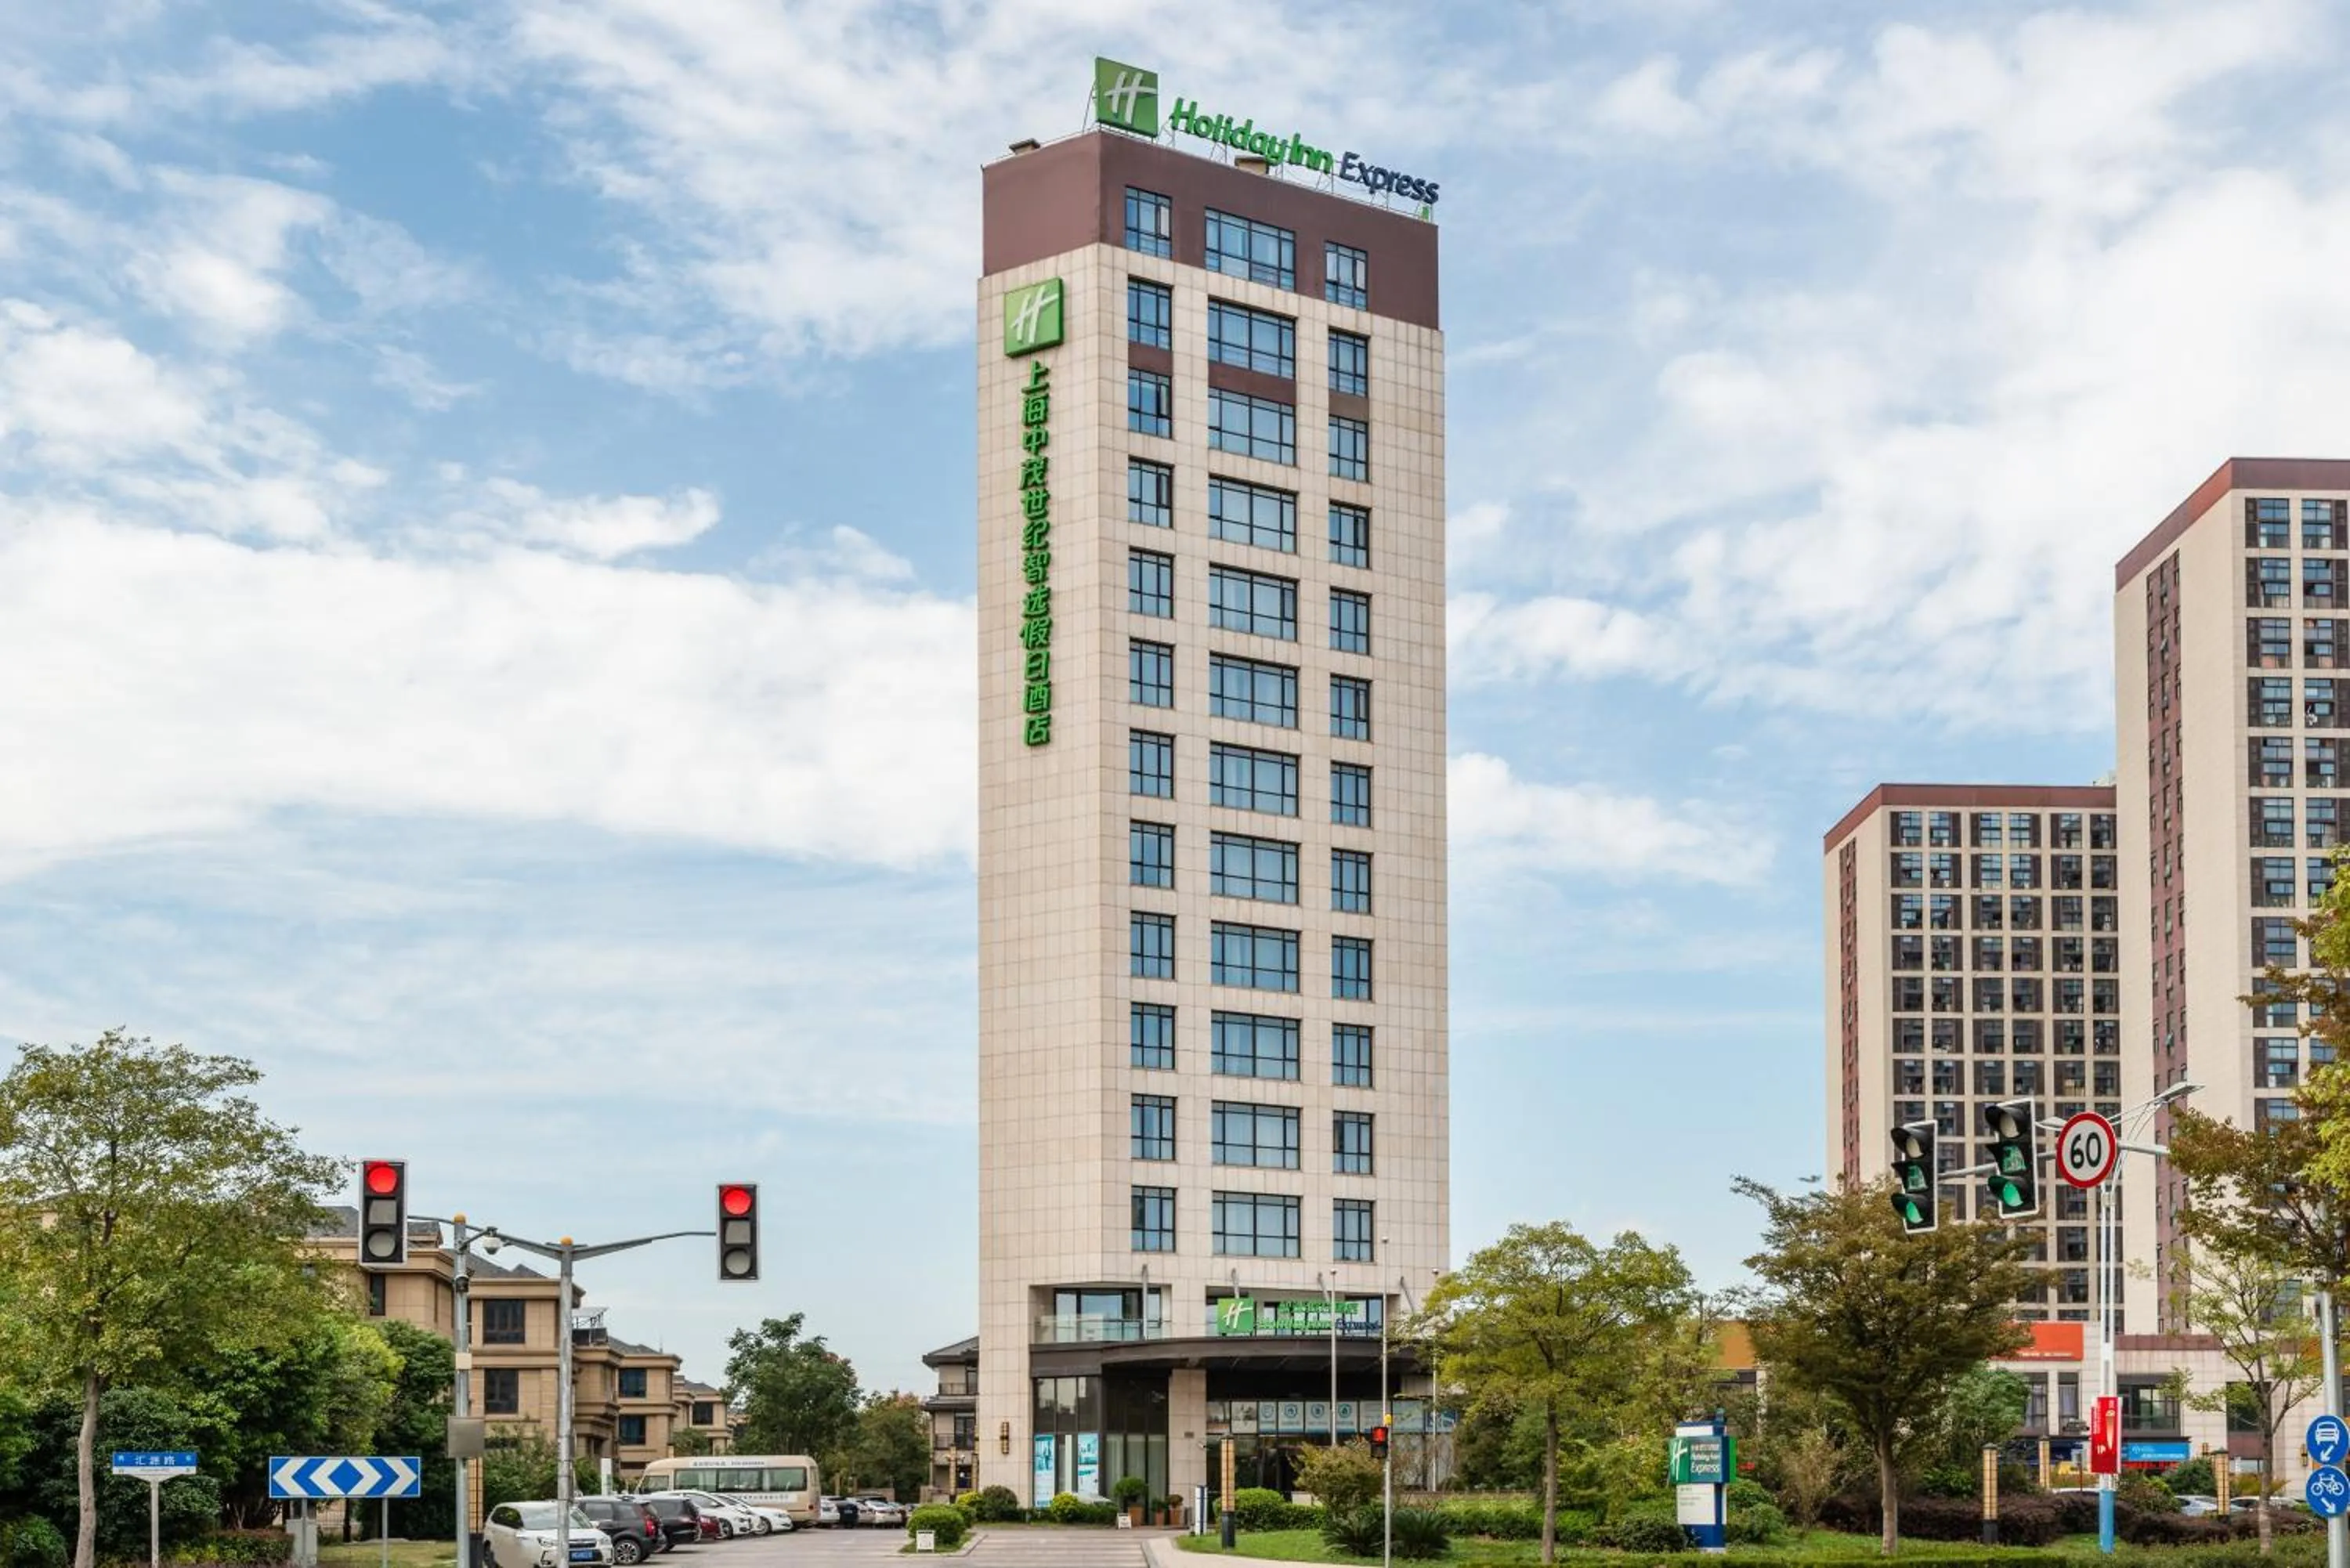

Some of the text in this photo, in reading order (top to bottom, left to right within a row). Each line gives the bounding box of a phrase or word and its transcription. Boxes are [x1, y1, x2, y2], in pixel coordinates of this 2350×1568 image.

[1170, 96, 1441, 205] Holiday Inn Express
[2070, 1132, 2102, 1169] 60
